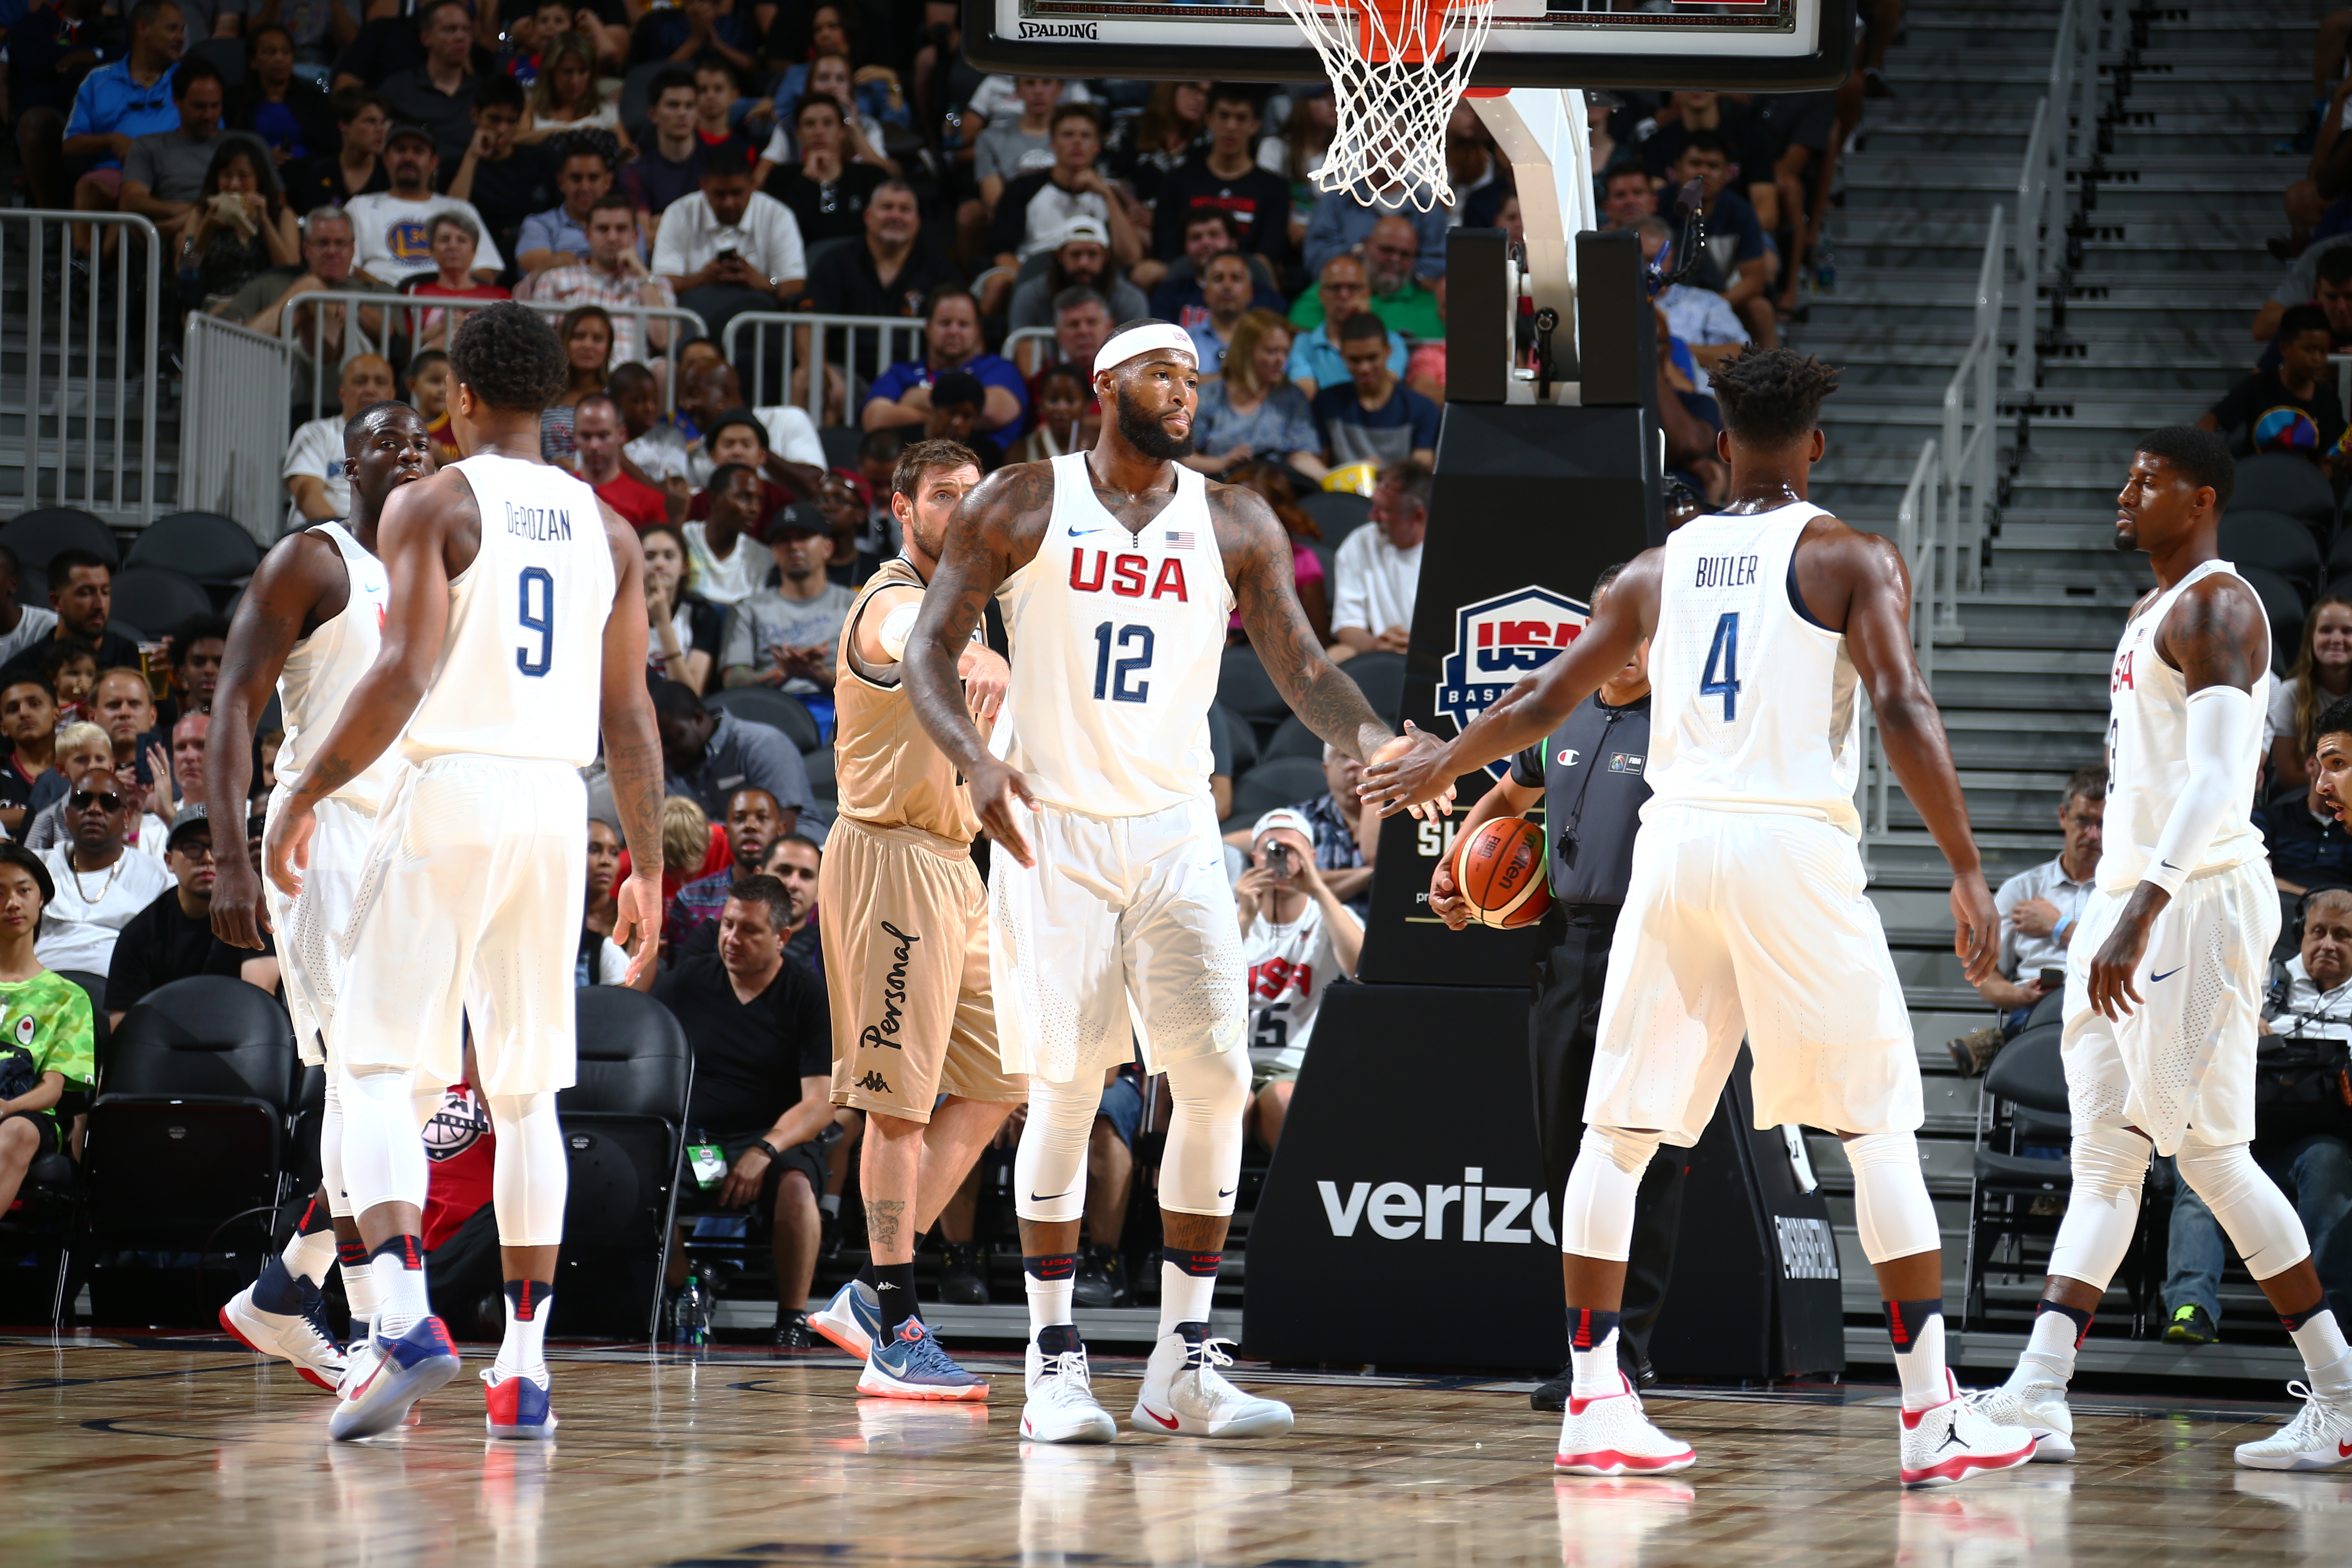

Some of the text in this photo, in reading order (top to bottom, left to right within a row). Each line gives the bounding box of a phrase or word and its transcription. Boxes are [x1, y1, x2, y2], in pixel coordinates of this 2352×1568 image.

[1019, 21, 1100, 40] SPALDING
[505, 501, 572, 541] DeROZAN
[1068, 547, 1189, 603] USA
[1695, 555, 1758, 588] BUTLER
[515, 565, 554, 679] 9
[1093, 621, 1155, 704] 12
[1700, 611, 1742, 724] 4
[2112, 650, 2135, 693] SA
[1499, 832, 1537, 890] molten
[860, 921, 920, 1050] Personal
[1041, 1258, 1073, 1266] USA
